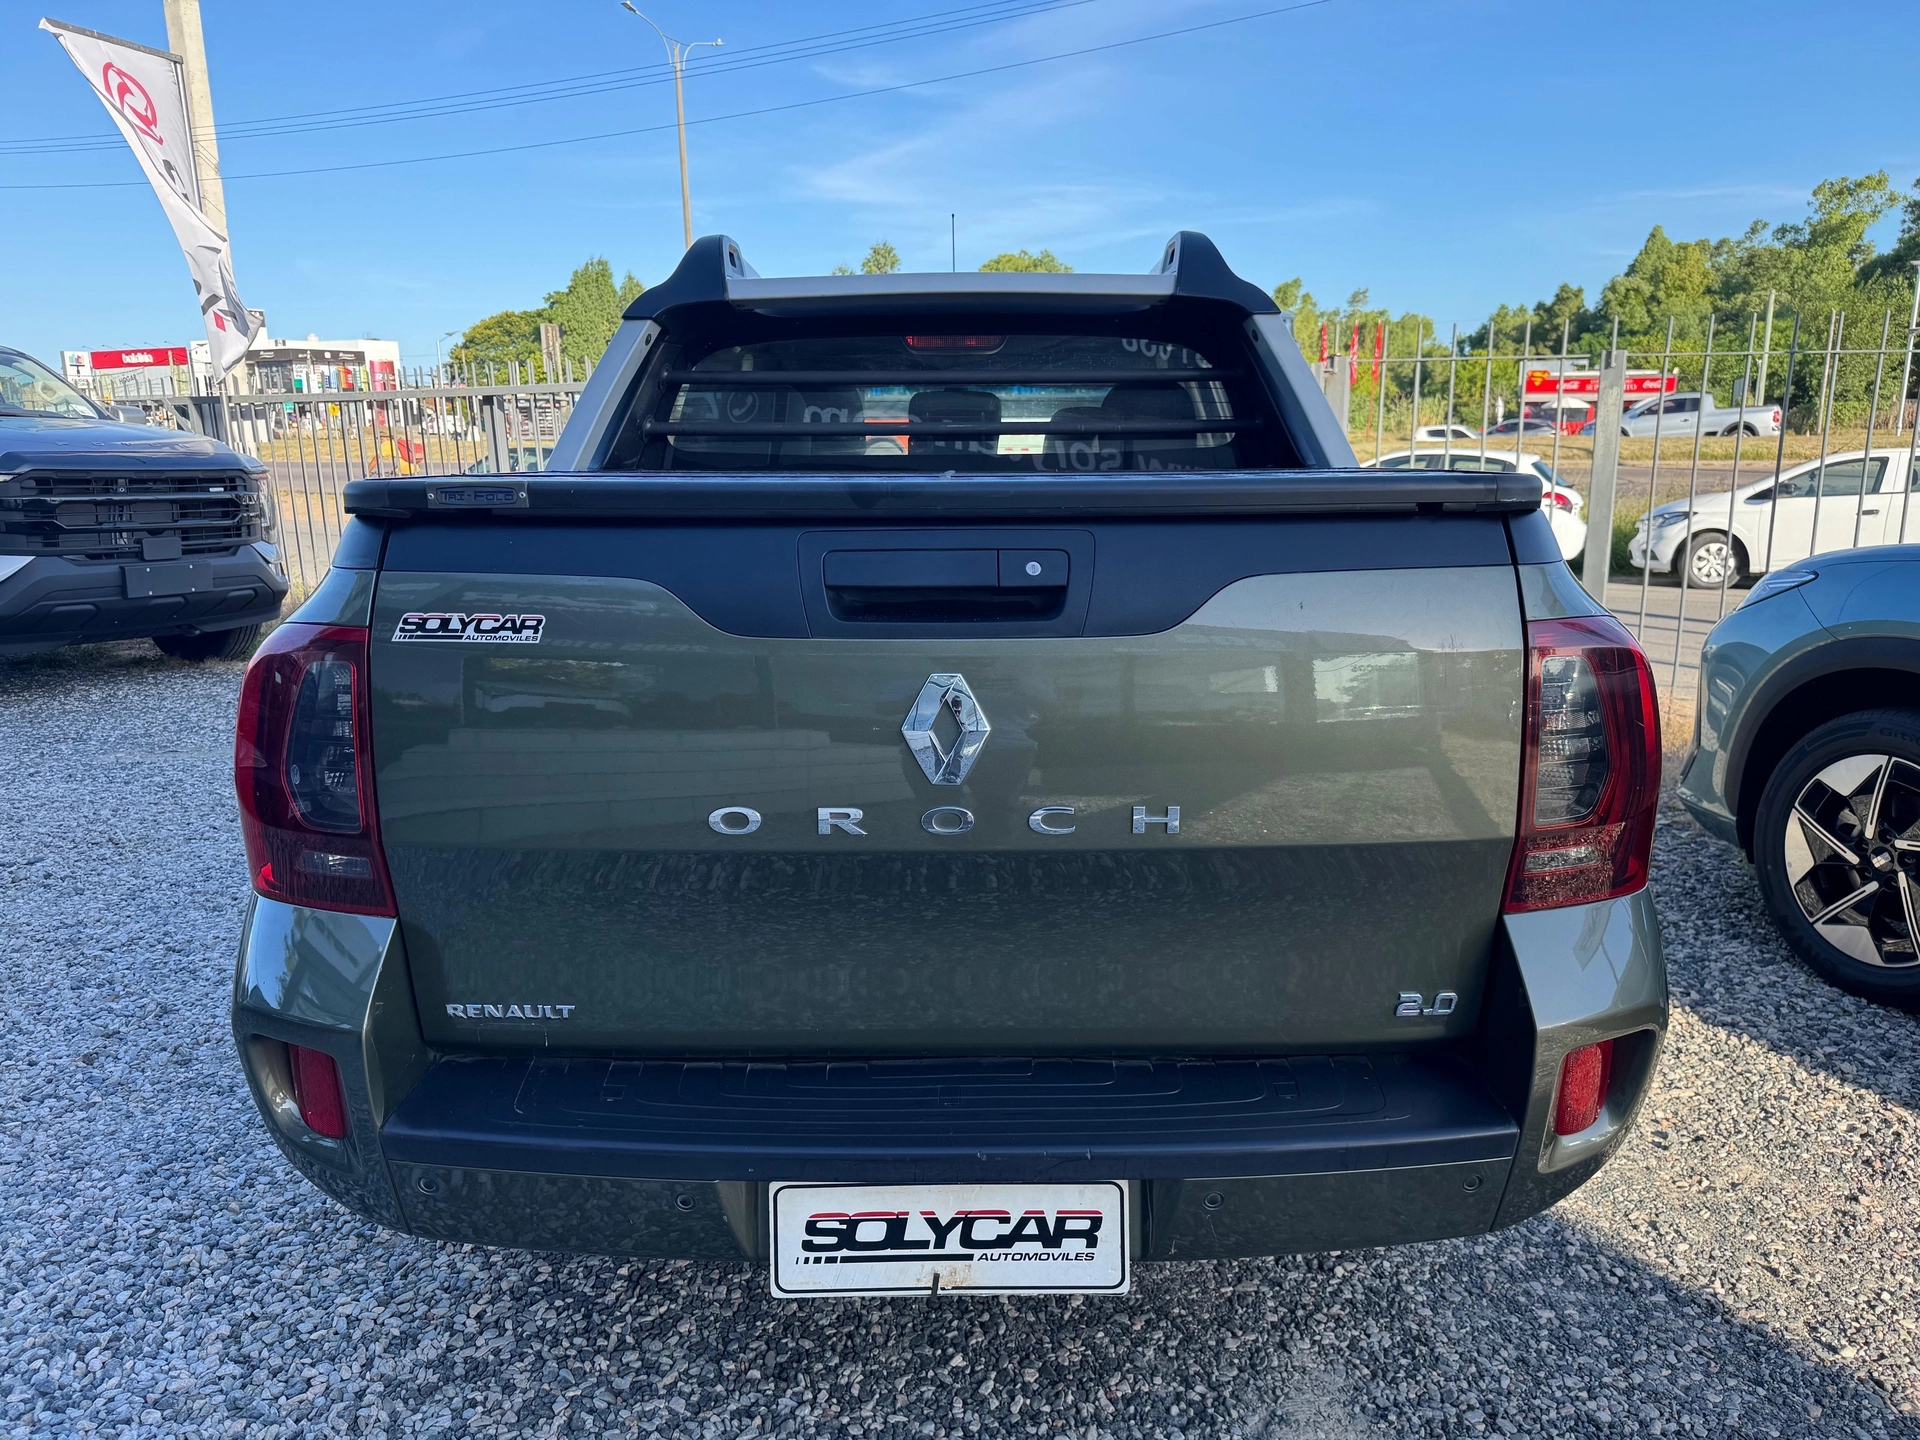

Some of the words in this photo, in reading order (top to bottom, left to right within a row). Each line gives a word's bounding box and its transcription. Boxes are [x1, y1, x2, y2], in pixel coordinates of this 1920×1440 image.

[439, 490, 514, 502] TRI-FOLD
[398, 614, 545, 635] SOLYCAR
[464, 634, 539, 642] AUTOMOVILES
[708, 806, 1180, 836] OROCH
[445, 1004, 576, 1019] RENAULT
[1396, 990, 1458, 1016] 2.0
[801, 1209, 1104, 1253] SOLYCAR
[977, 1252, 1096, 1262] AUTOMOVILES
